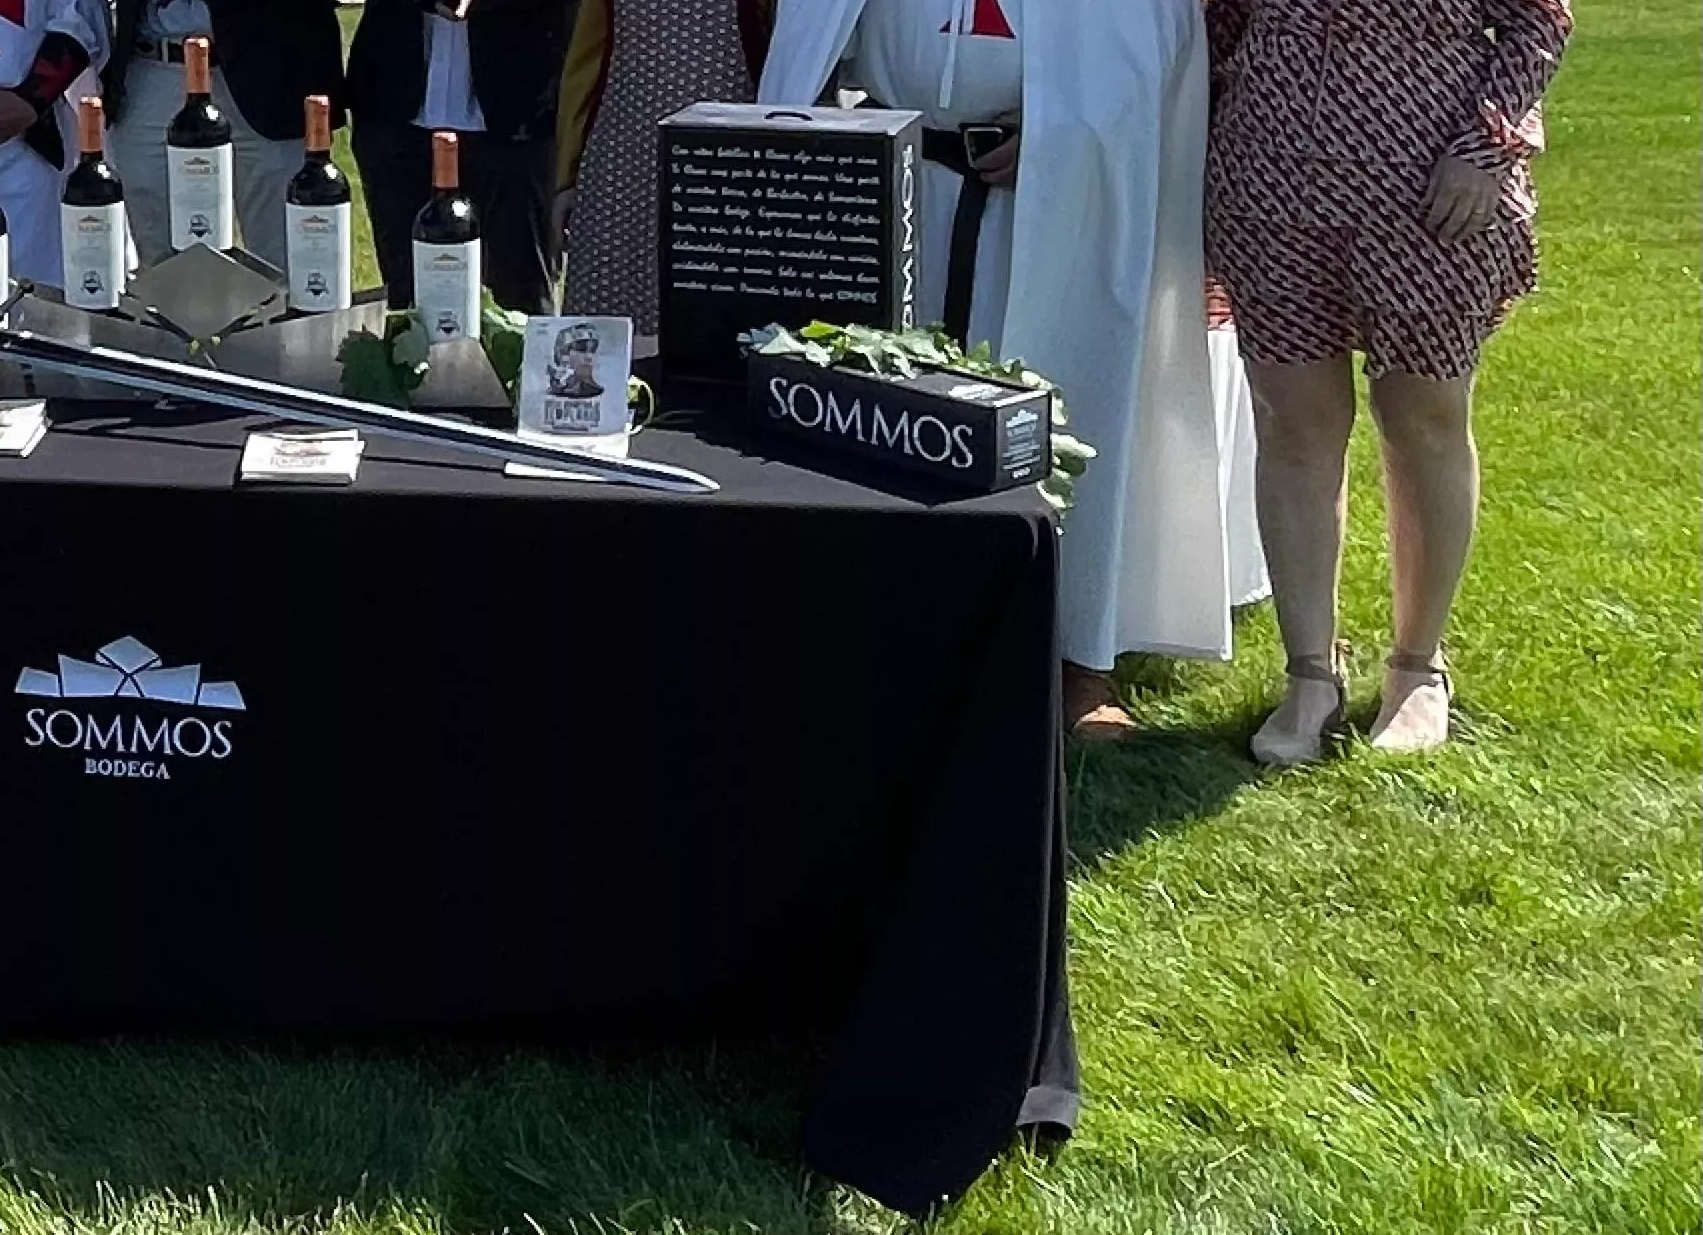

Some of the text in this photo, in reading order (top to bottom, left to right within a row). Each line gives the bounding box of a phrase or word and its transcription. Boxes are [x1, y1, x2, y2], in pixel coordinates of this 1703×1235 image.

[901, 144, 914, 330] SOMMO
[767, 376, 974, 469] SOMMOS
[24, 708, 233, 758] SOMMOS
[84, 757, 171, 779] BODEGA
